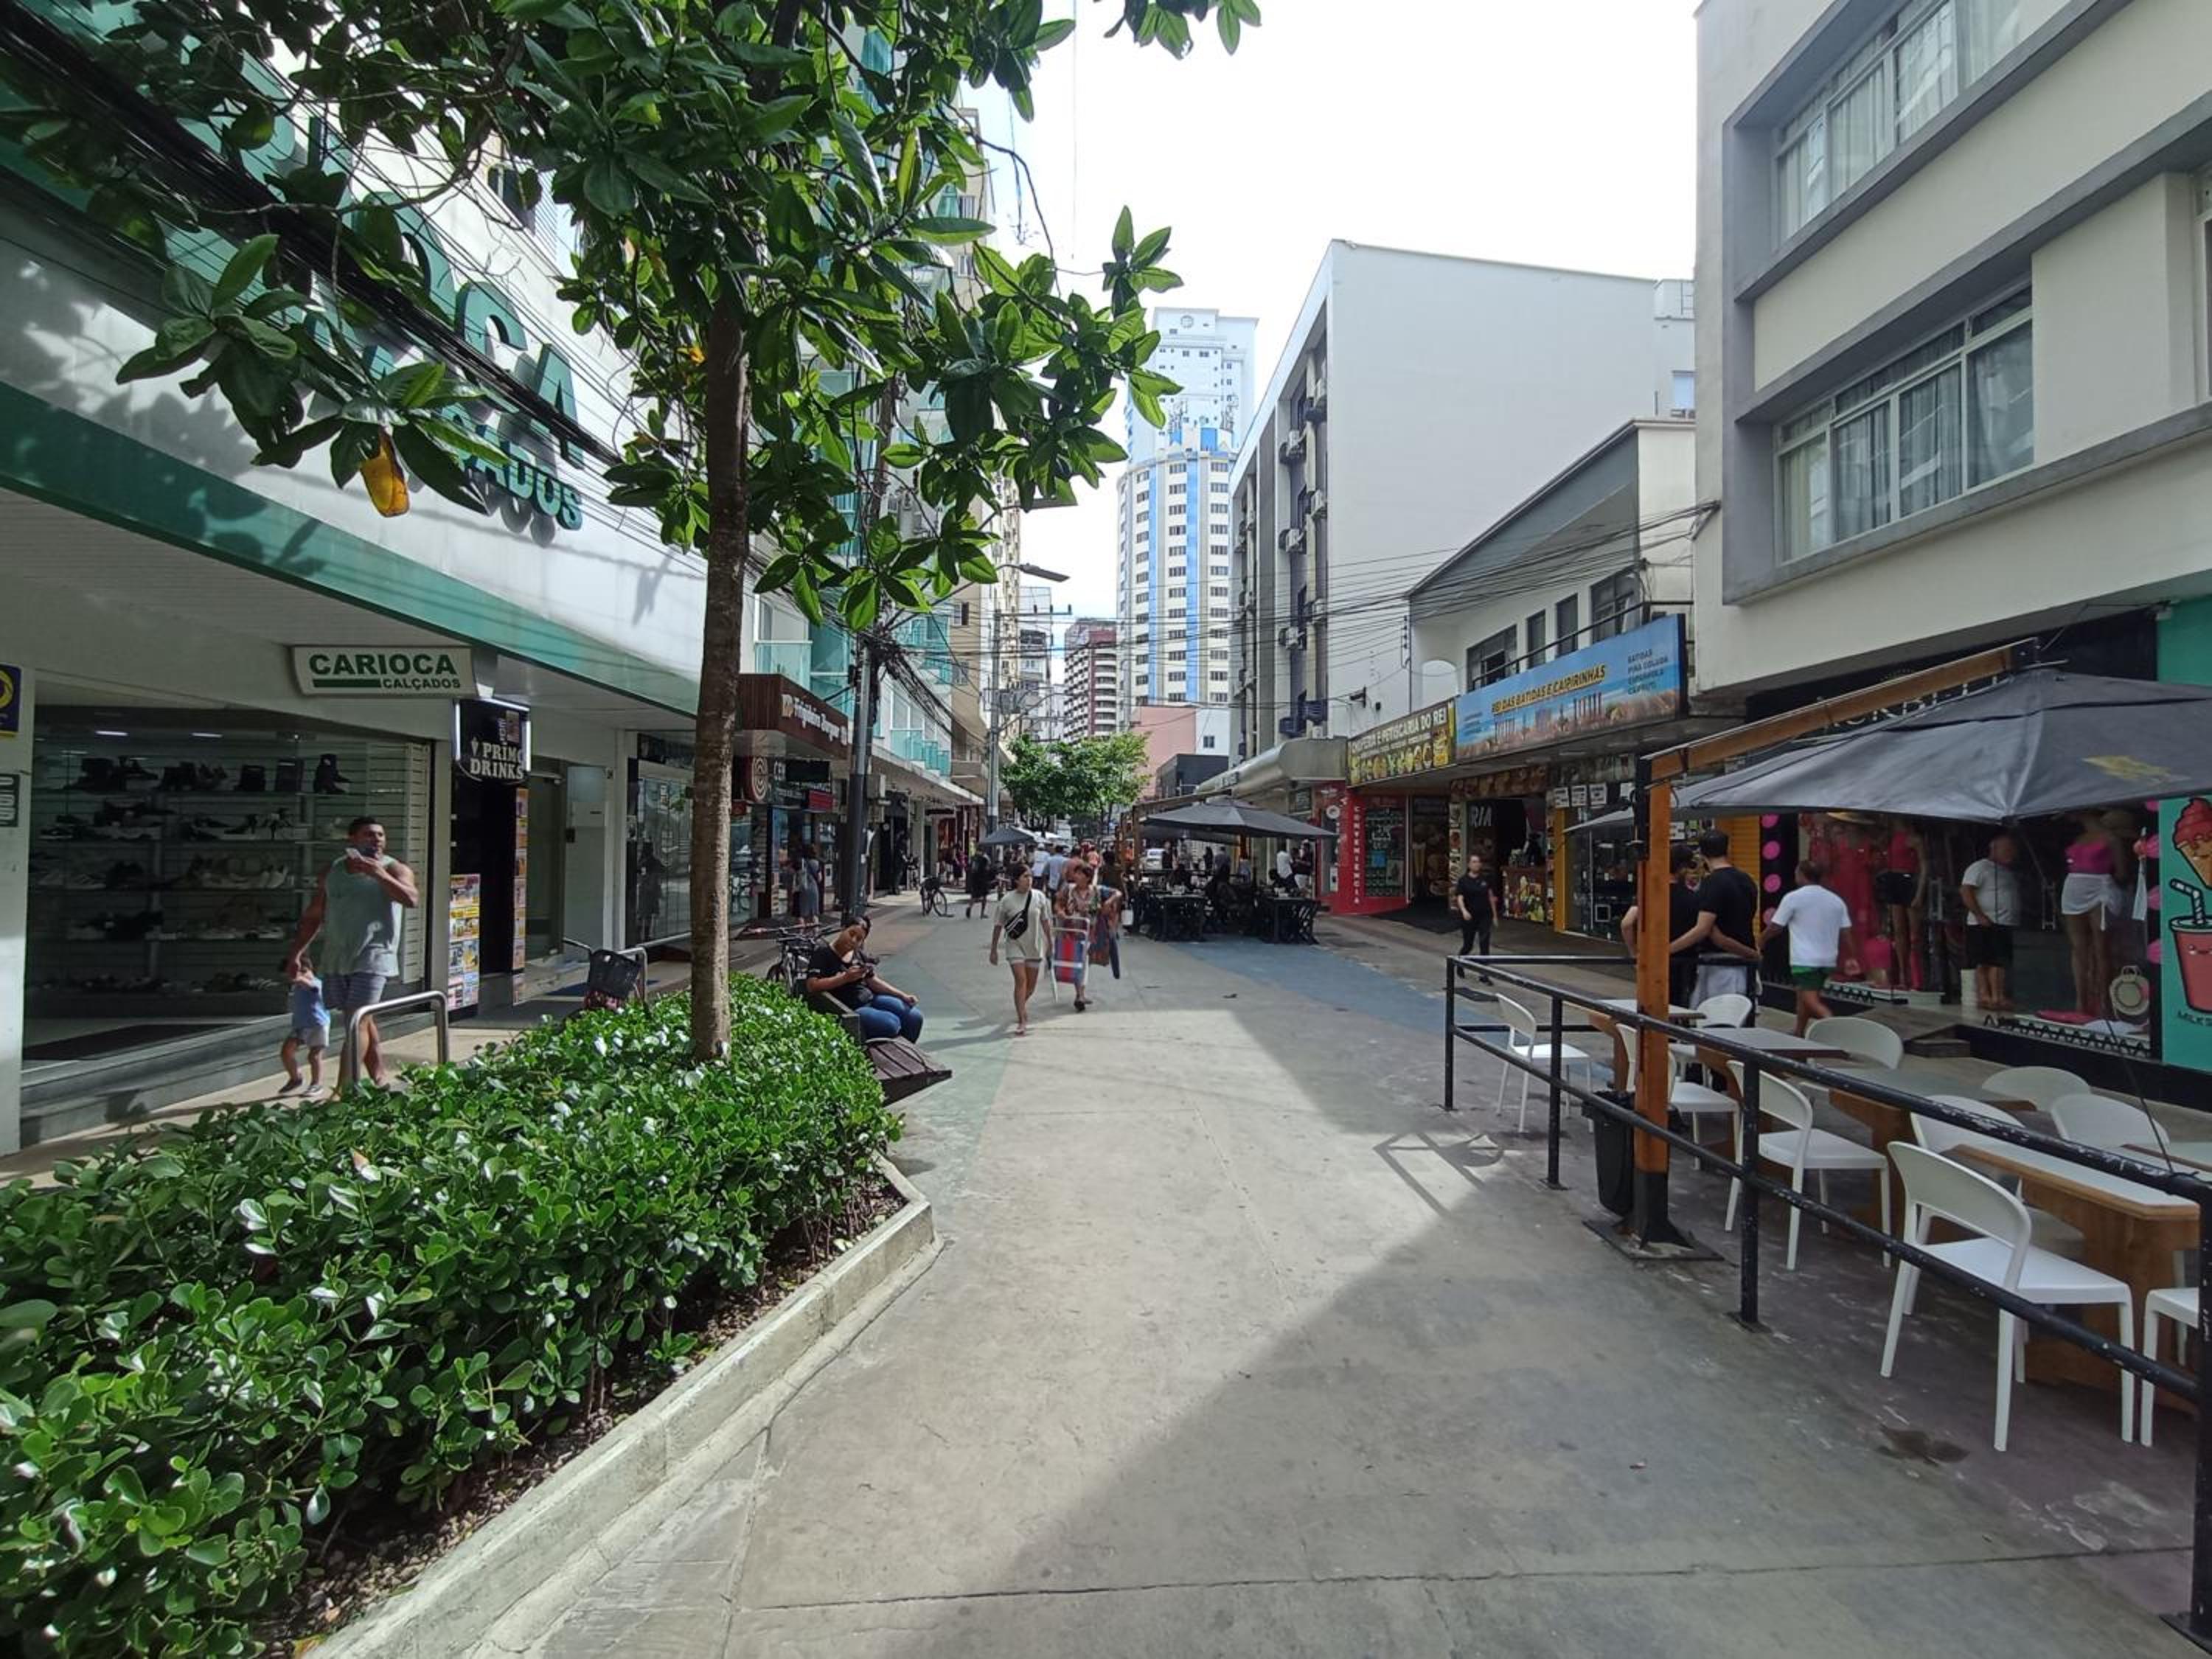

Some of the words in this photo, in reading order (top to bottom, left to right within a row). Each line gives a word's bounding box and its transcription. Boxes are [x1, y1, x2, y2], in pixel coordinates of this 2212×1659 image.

[309, 654, 457, 675] CARIOCA
[383, 678, 461, 691] CALÇADOS
[1420, 713, 1431, 731] DO
[1433, 707, 1447, 728] REI
[470, 757, 524, 779] DRINKS
